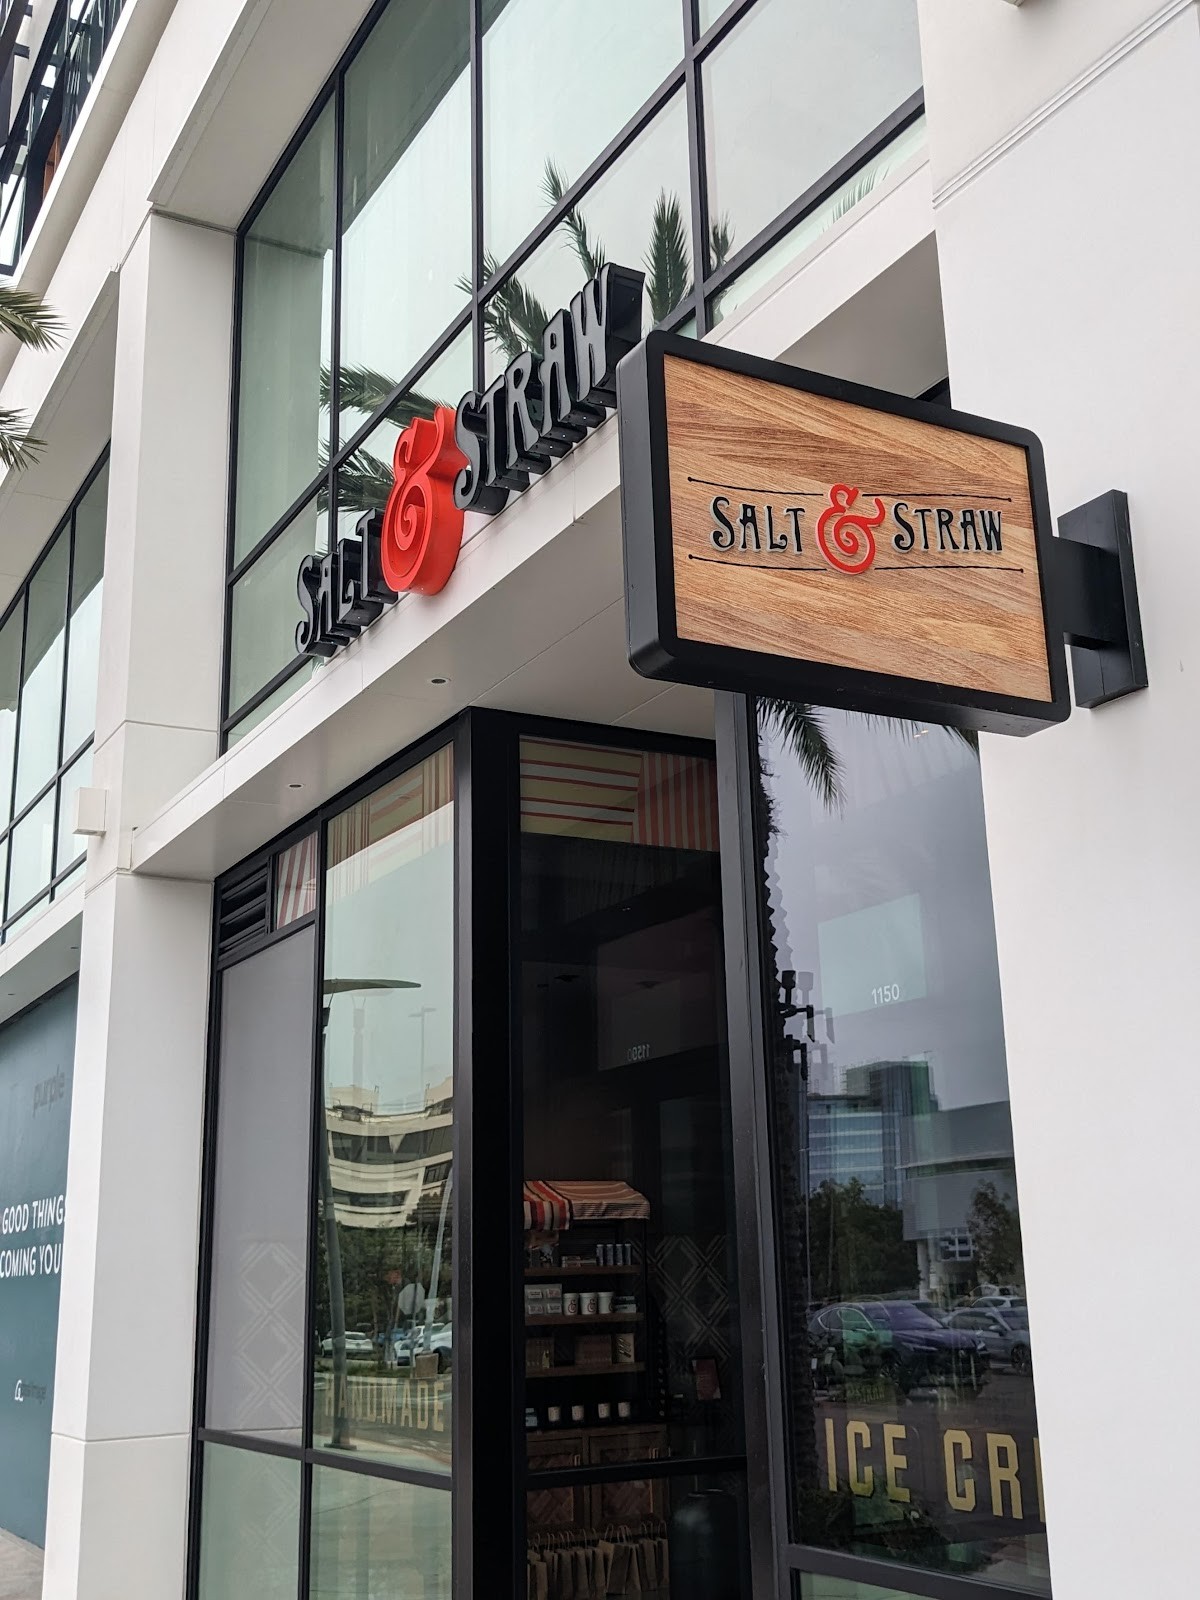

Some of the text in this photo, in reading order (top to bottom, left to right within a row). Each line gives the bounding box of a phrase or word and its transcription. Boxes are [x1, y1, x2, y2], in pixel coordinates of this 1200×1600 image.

[296, 262, 640, 657] SALT & STRAW
[710, 483, 1003, 574] SALT & STRAW
[871, 983, 900, 1005] 1150
[2, 1194, 67, 1235] GOOD THING
[0, 1246, 36, 1279] COMING
[325, 1375, 445, 1432] HANDMADE
[825, 1418, 911, 1503] ICE
